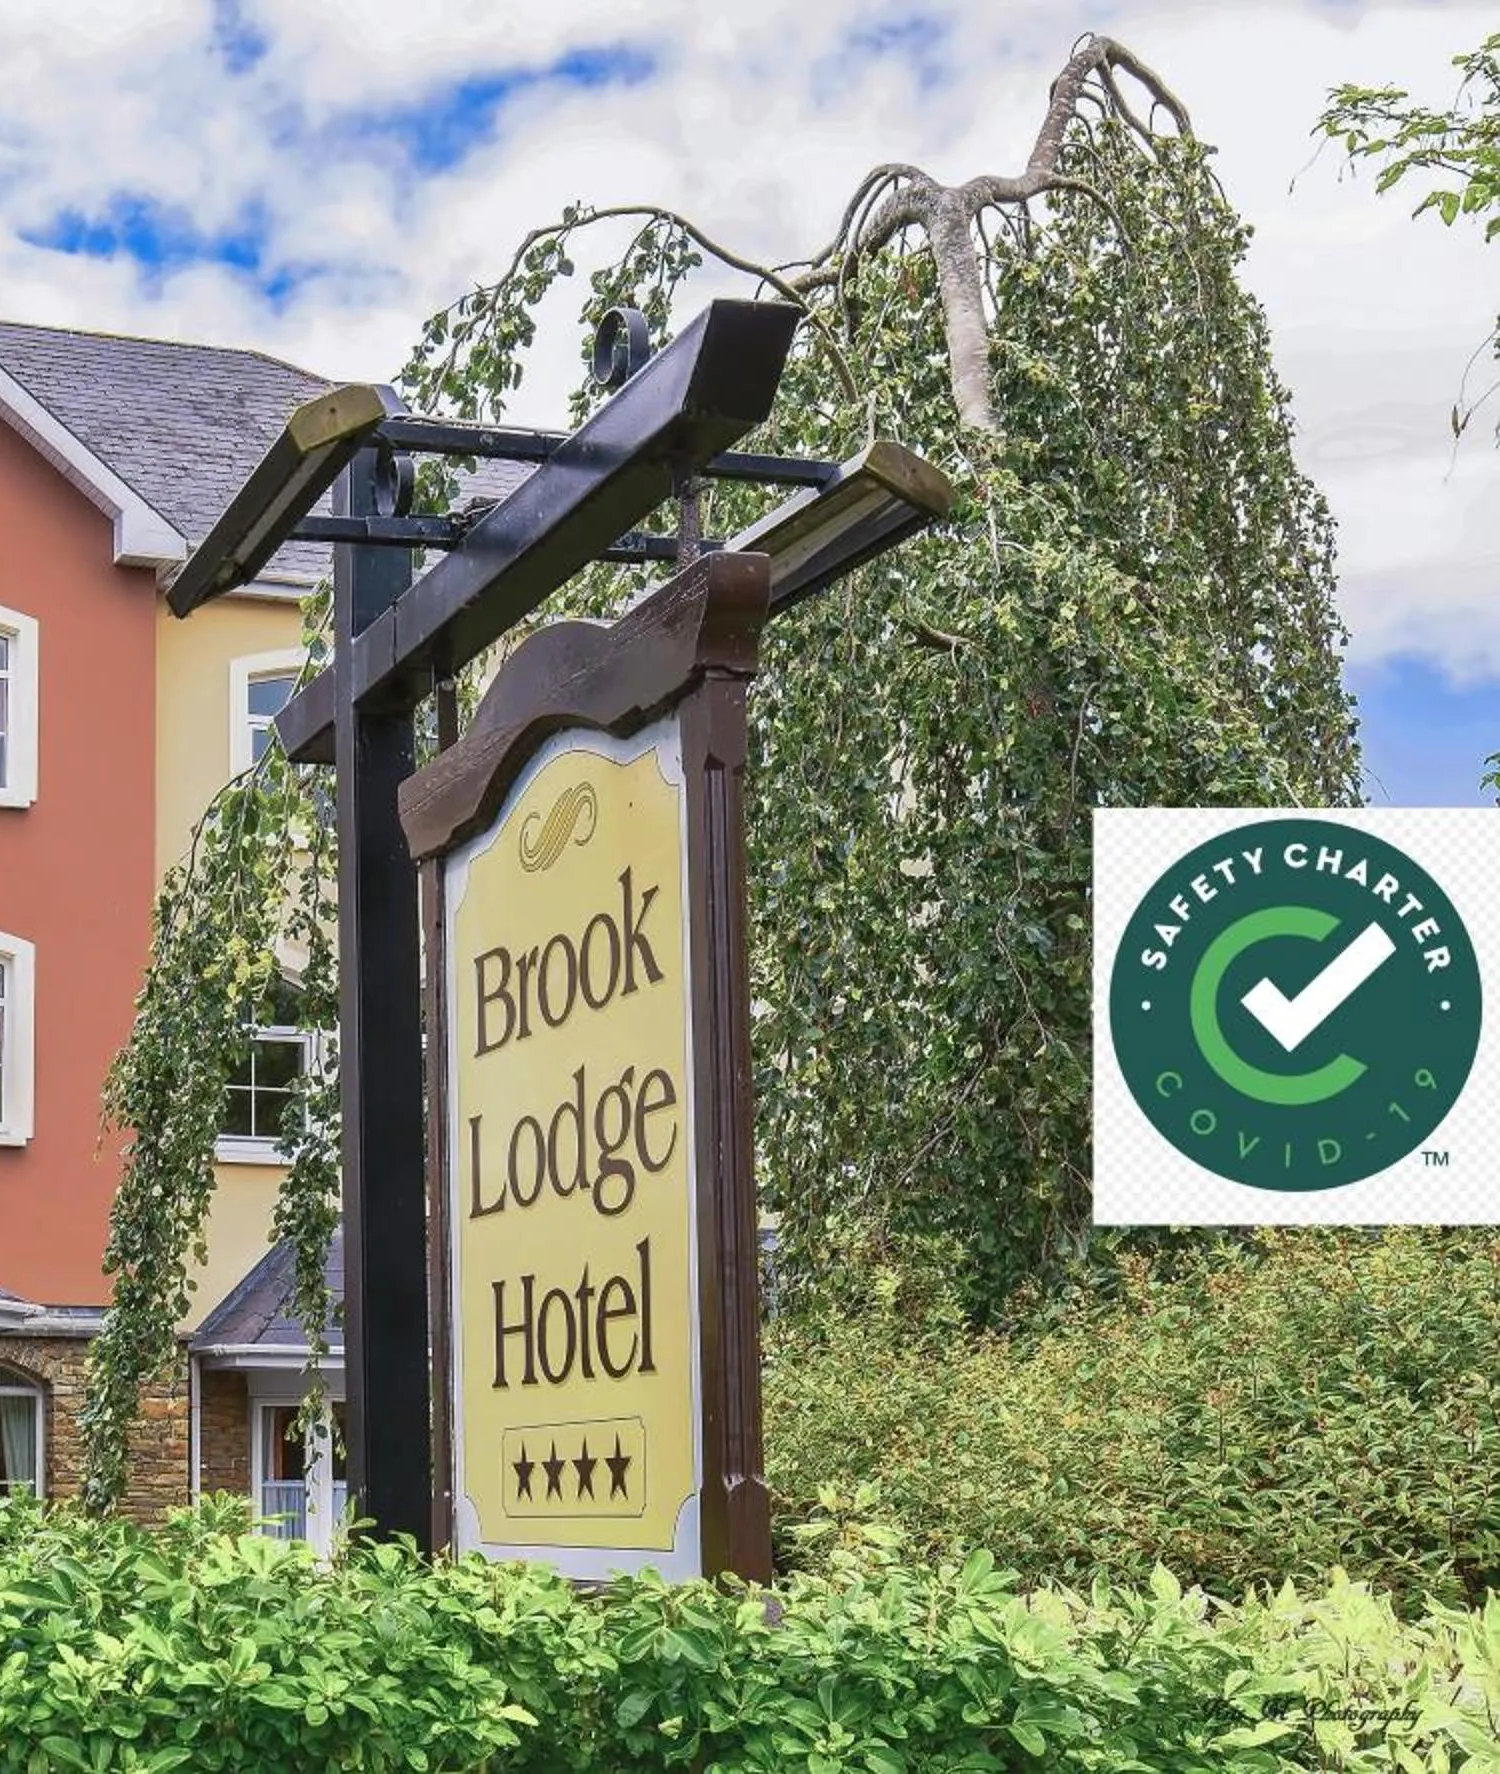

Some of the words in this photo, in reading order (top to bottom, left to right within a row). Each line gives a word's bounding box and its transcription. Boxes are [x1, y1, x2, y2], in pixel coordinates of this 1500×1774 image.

[473, 865, 664, 1058] Brook
[468, 1064, 677, 1219] Lodge
[491, 1236, 656, 1388] Hotel
